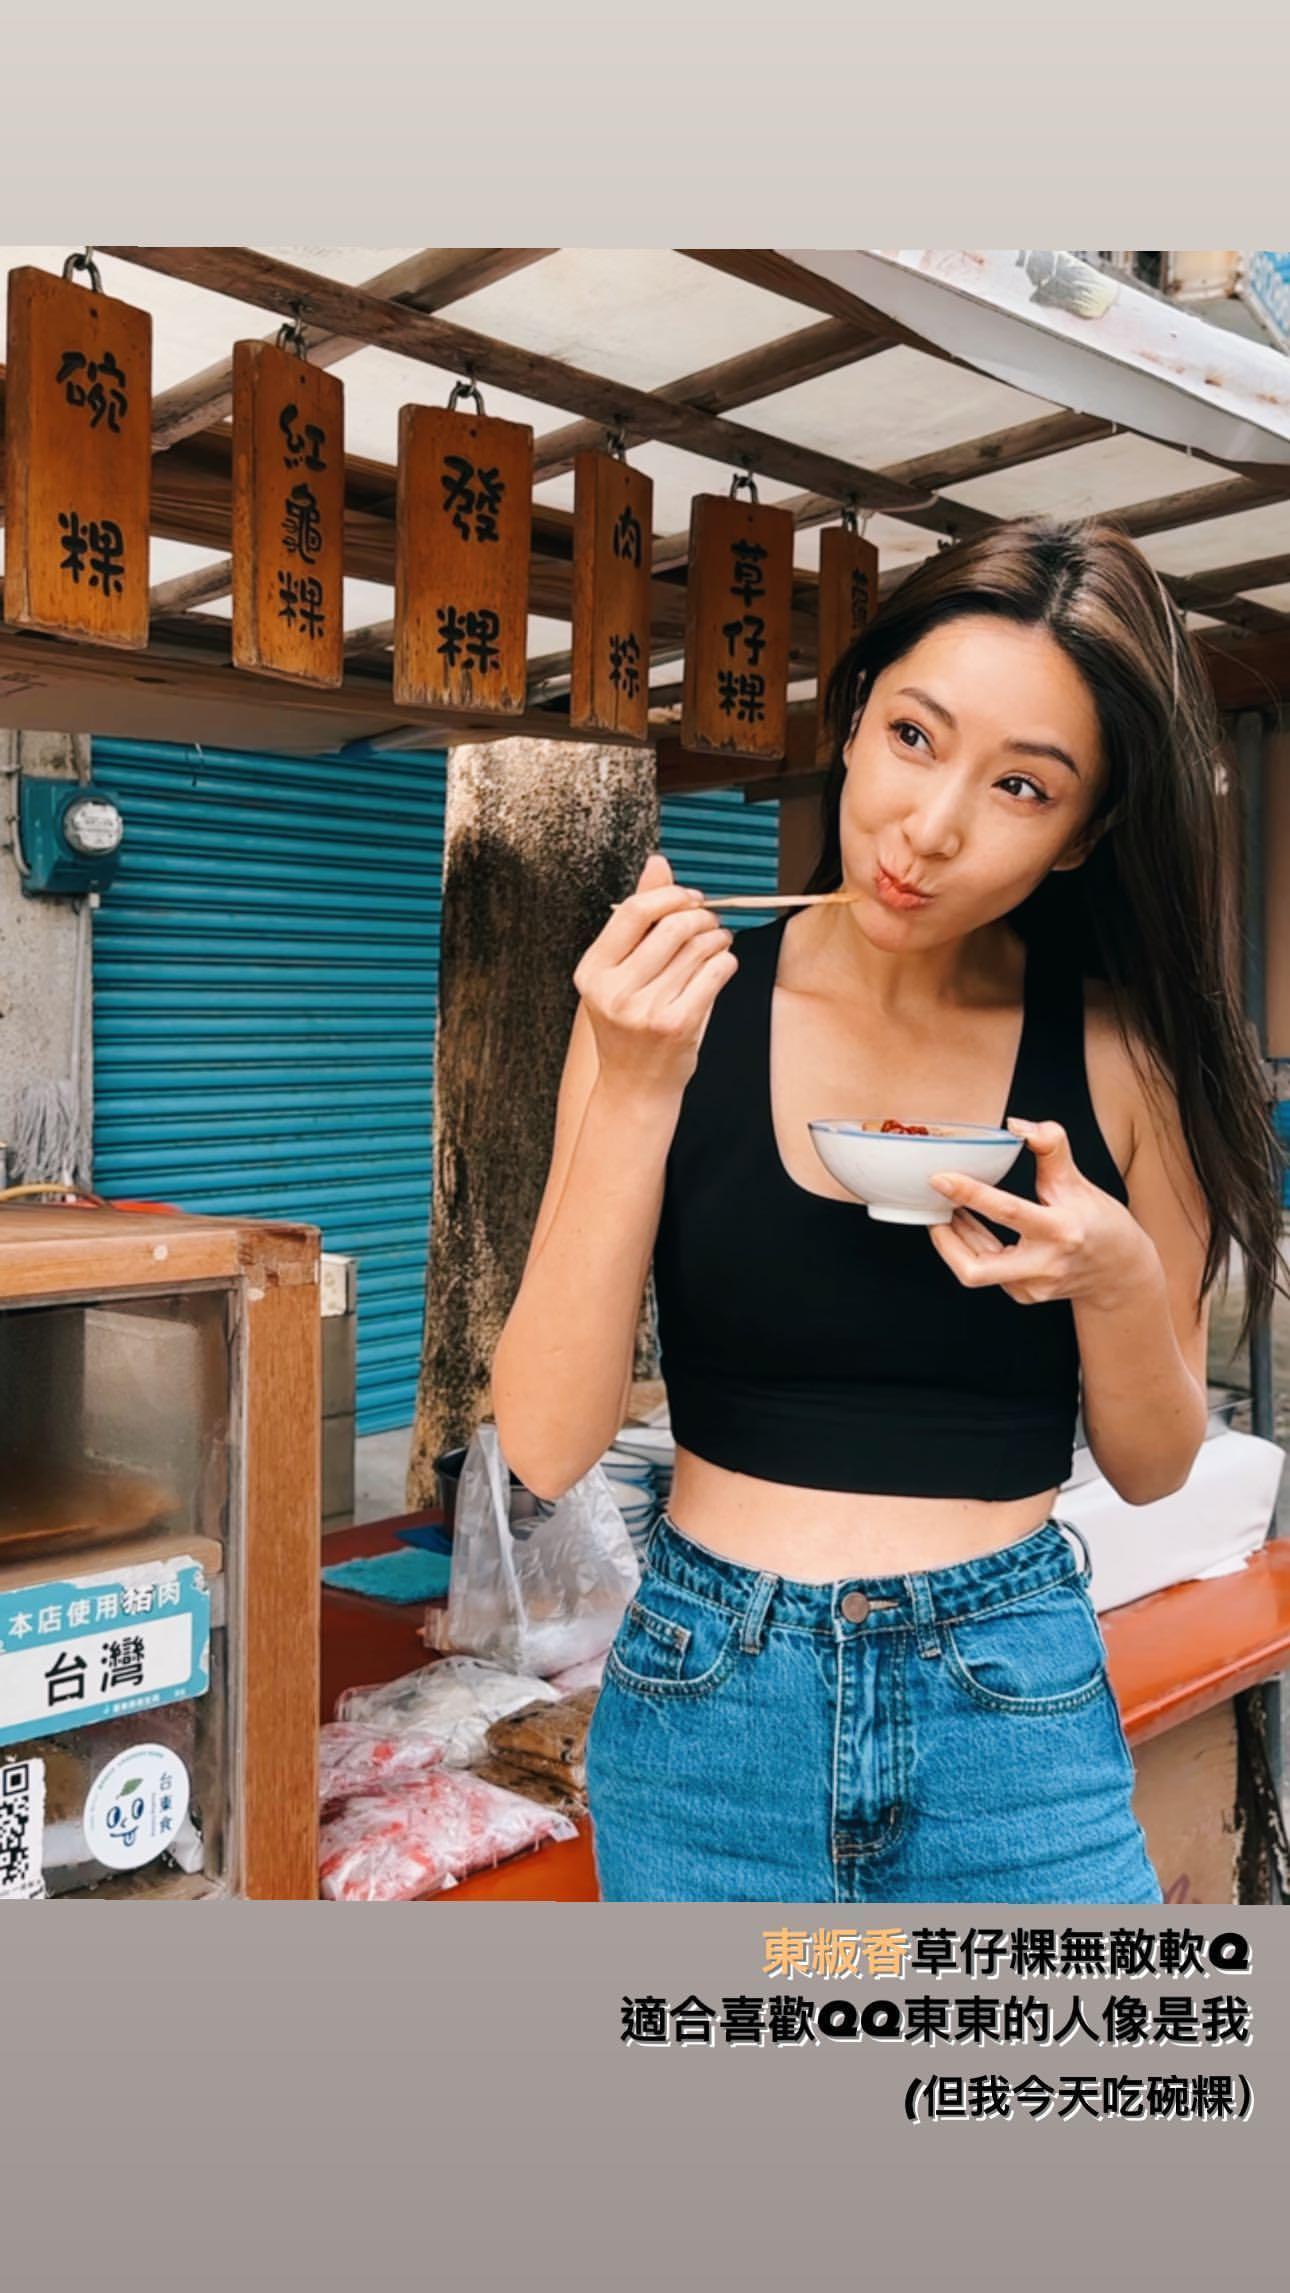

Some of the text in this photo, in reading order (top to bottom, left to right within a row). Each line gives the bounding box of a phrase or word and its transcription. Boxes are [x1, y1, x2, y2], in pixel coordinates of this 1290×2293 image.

[56, 352, 128, 597] 碗粿
[278, 403, 327, 639] 紅龜粿
[437, 455, 506, 674] 發粿
[609, 505, 642, 699] 肉粽
[718, 539, 768, 723] 草仔粿
[45, 1636, 145, 1706] 台灣
